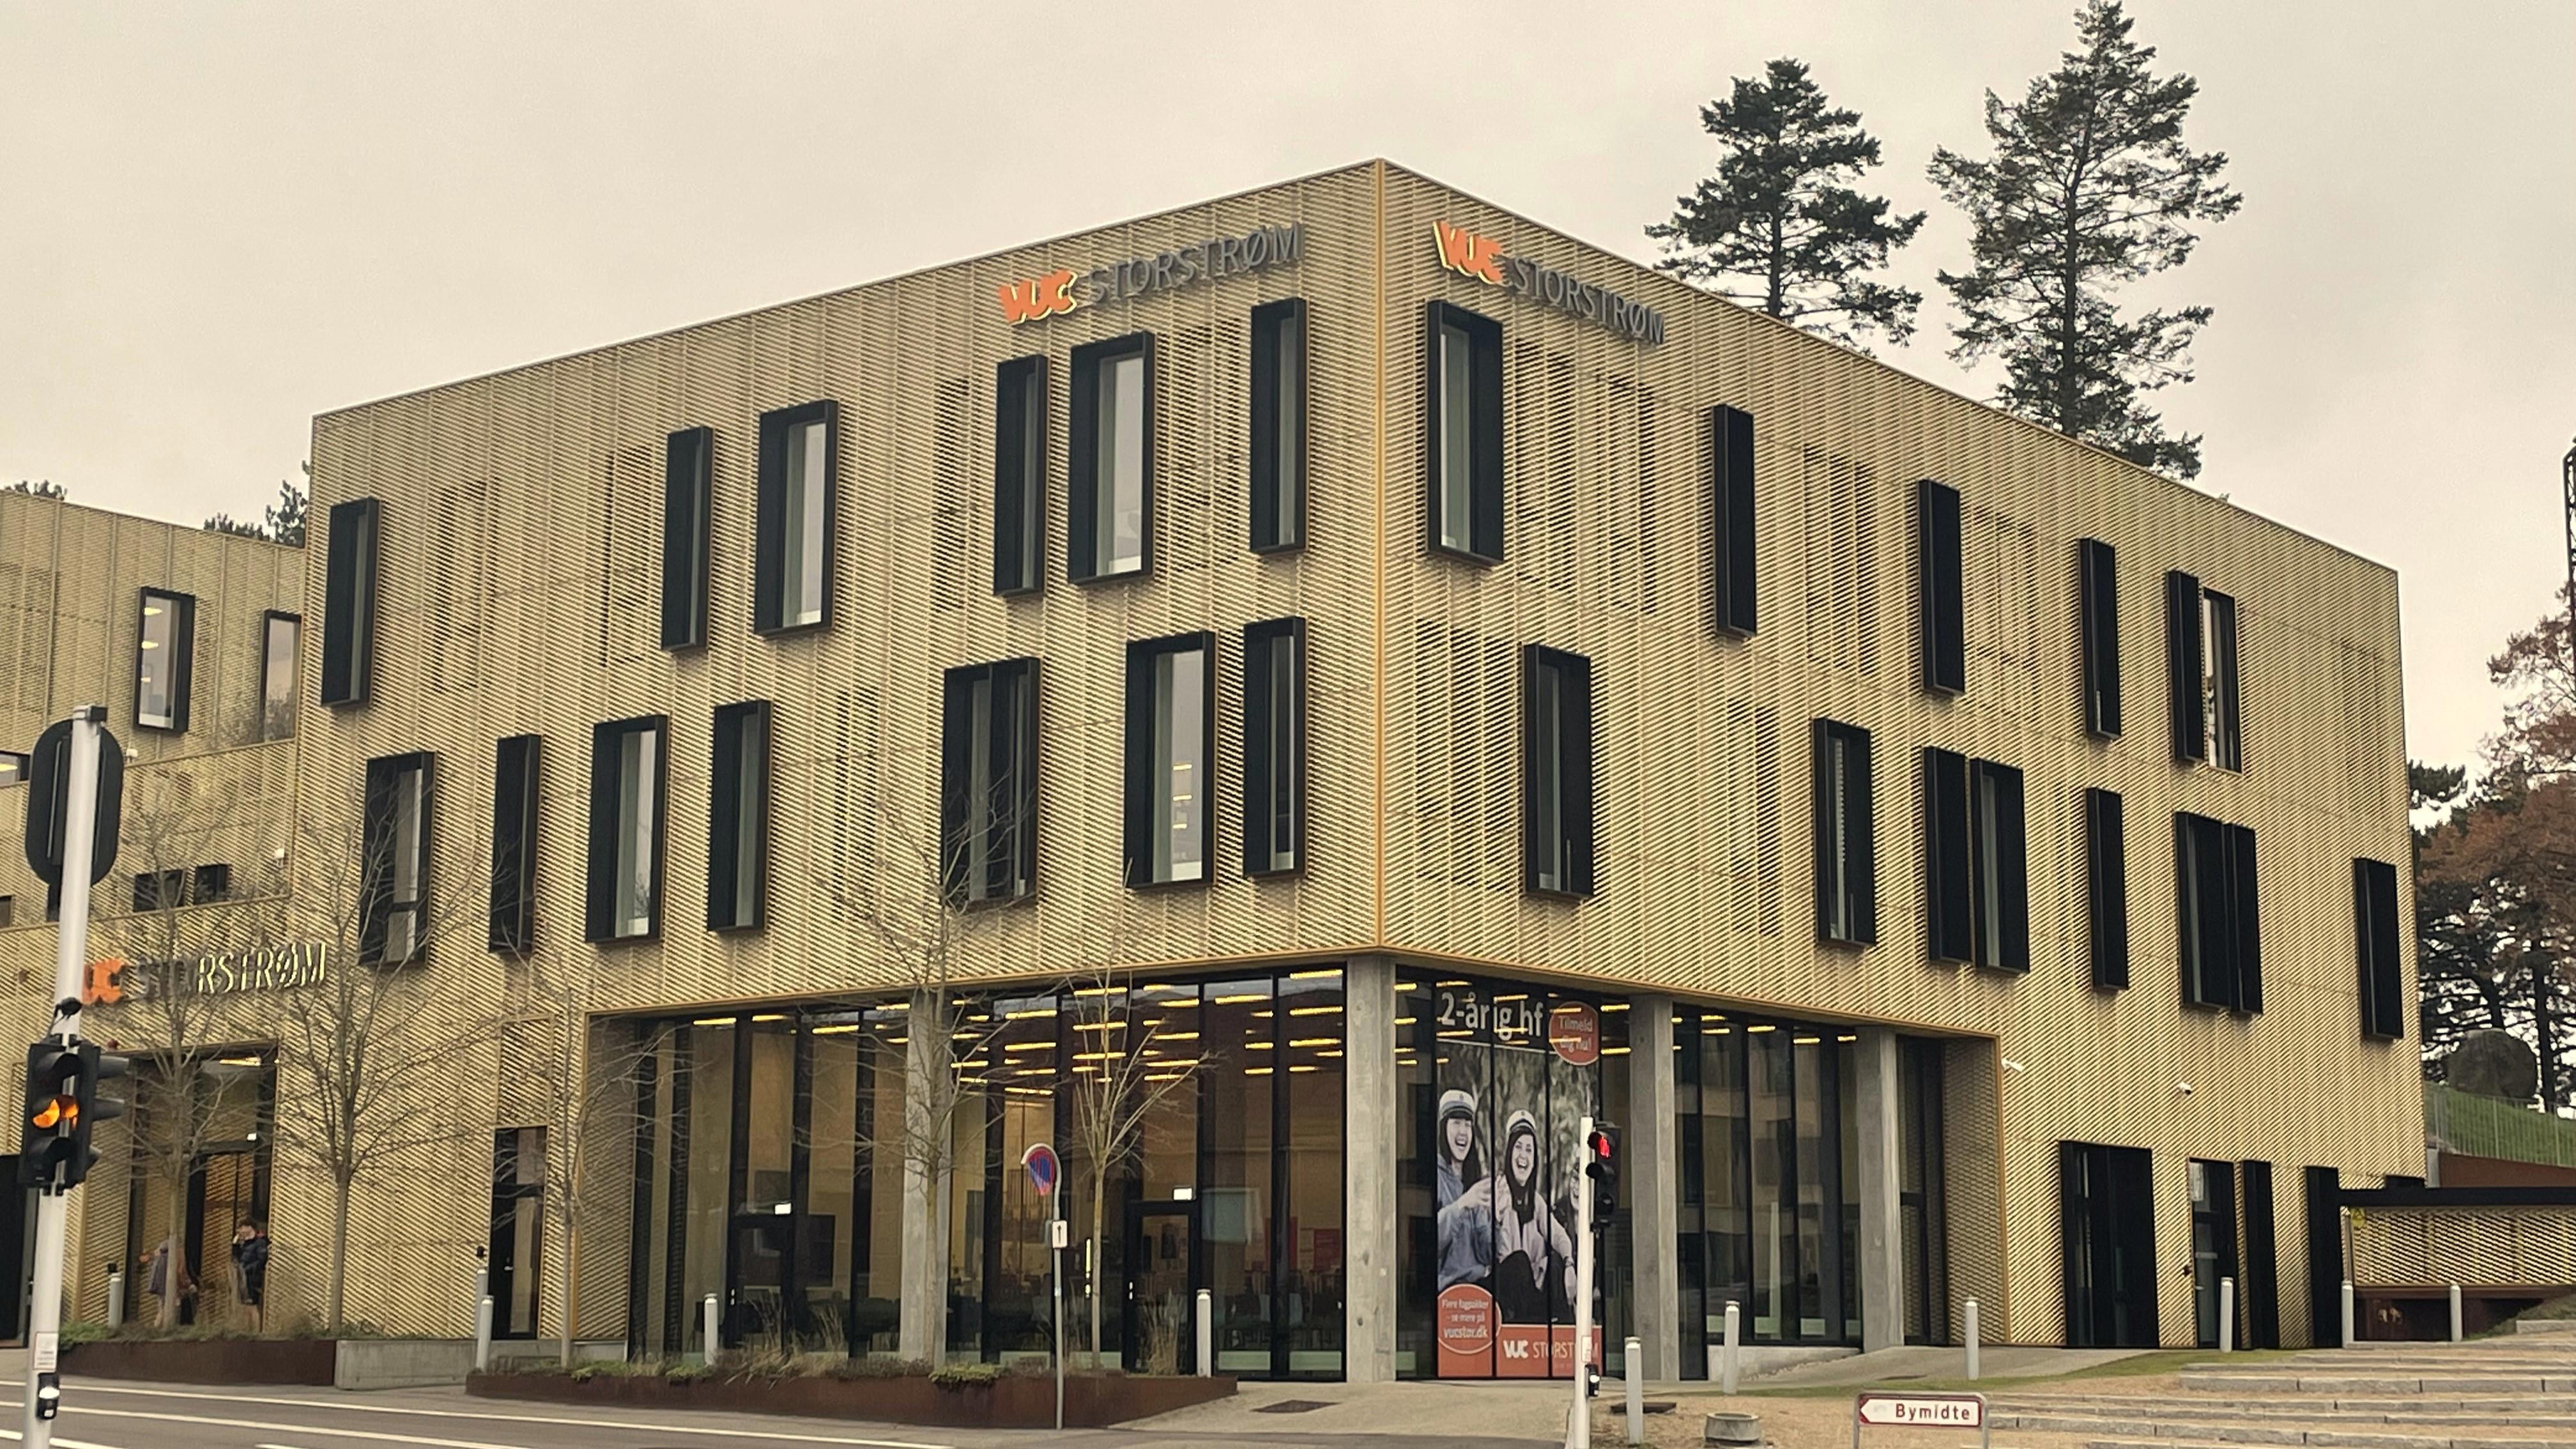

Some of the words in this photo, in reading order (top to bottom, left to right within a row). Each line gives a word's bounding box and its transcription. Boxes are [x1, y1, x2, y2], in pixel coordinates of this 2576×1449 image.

[997, 270, 1077, 323] VUC
[1088, 222, 1305, 303] STORSTRØM
[1433, 220, 1505, 286] VUC
[1512, 257, 1665, 344] STORSTRØM
[83, 958, 124, 1005] UC
[1441, 992, 1512, 1041] 2-årig
[1520, 1000, 1544, 1037] hf
[1558, 1015, 1593, 1032] Tilmeld
[1503, 1340, 1528, 1358] VUC
[1896, 1403, 1970, 1421] Bymidte
